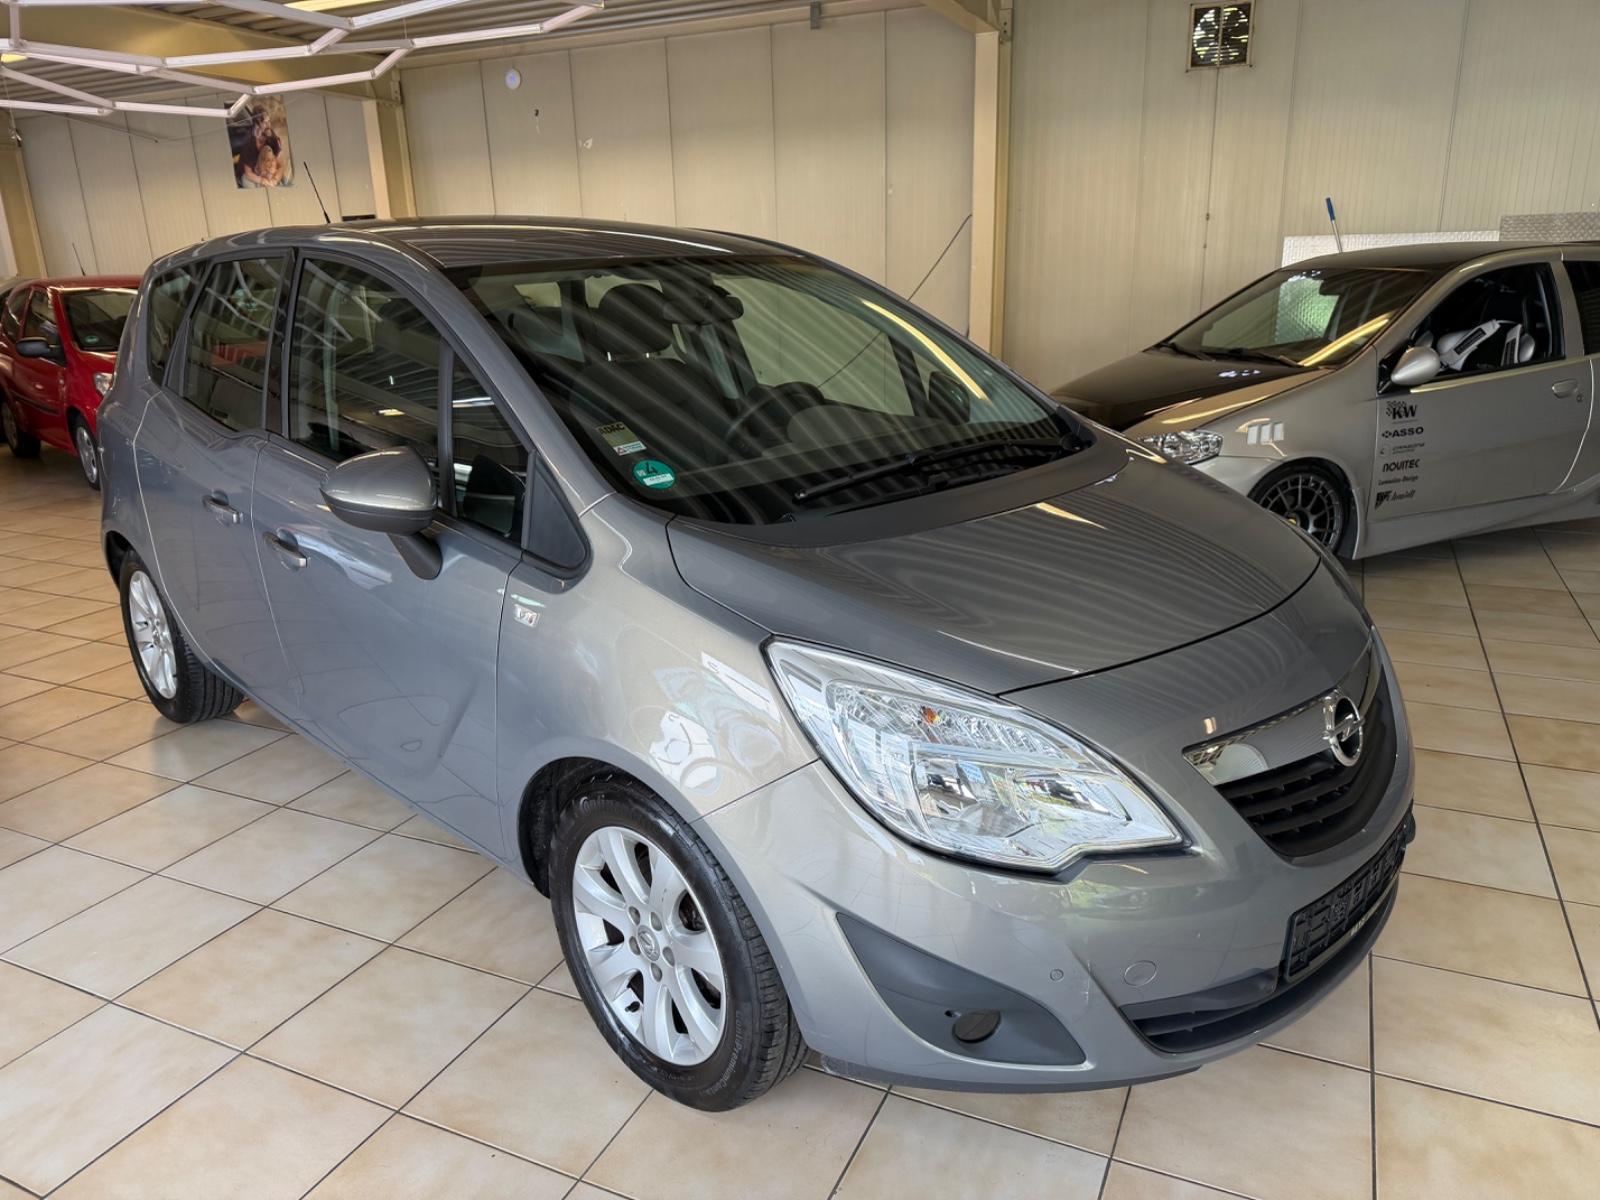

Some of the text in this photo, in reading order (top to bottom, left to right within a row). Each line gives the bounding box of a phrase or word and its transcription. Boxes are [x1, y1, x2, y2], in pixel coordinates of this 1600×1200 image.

[1392, 405, 1417, 420] KW
[1392, 426, 1424, 438] ASSO
[646, 462, 658, 474] 4
